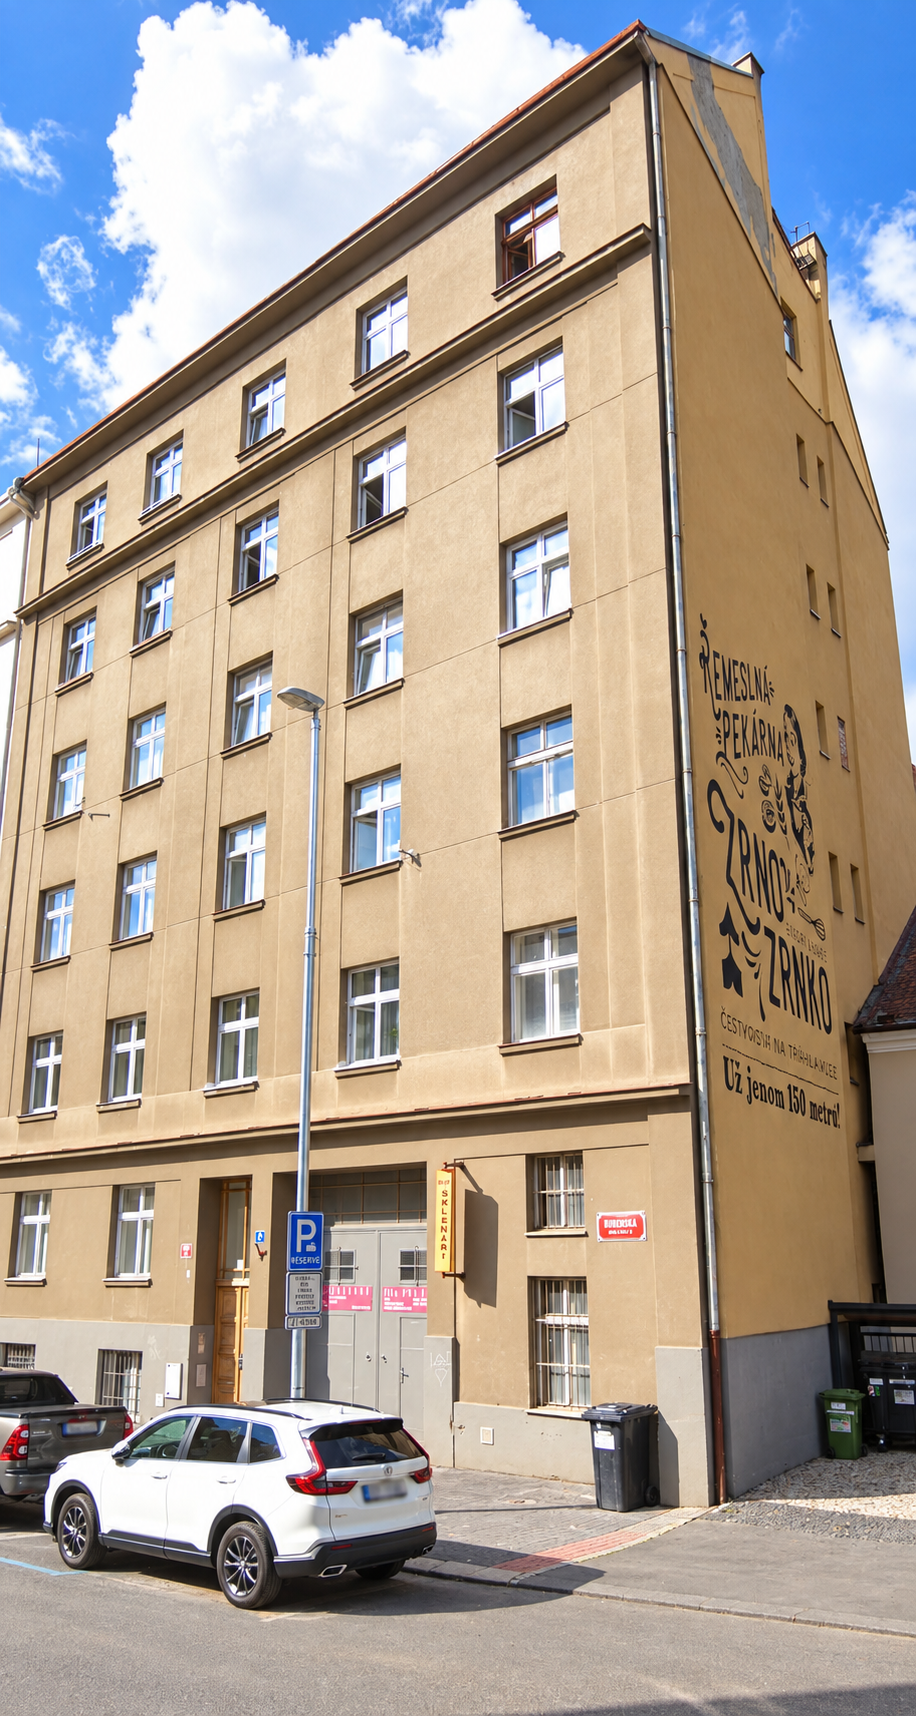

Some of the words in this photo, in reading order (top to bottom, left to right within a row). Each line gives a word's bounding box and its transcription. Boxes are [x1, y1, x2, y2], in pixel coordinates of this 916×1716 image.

[699, 613, 771, 721] ŘEMESLNÁ
[719, 708, 784, 772] PEKÁRNA
[707, 779, 784, 935] ZRNO
[763, 925, 833, 1035] ZRNKO
[723, 1055, 743, 1094] Už
[746, 1065, 785, 1109] jenom
[787, 1083, 806, 1117] 150
